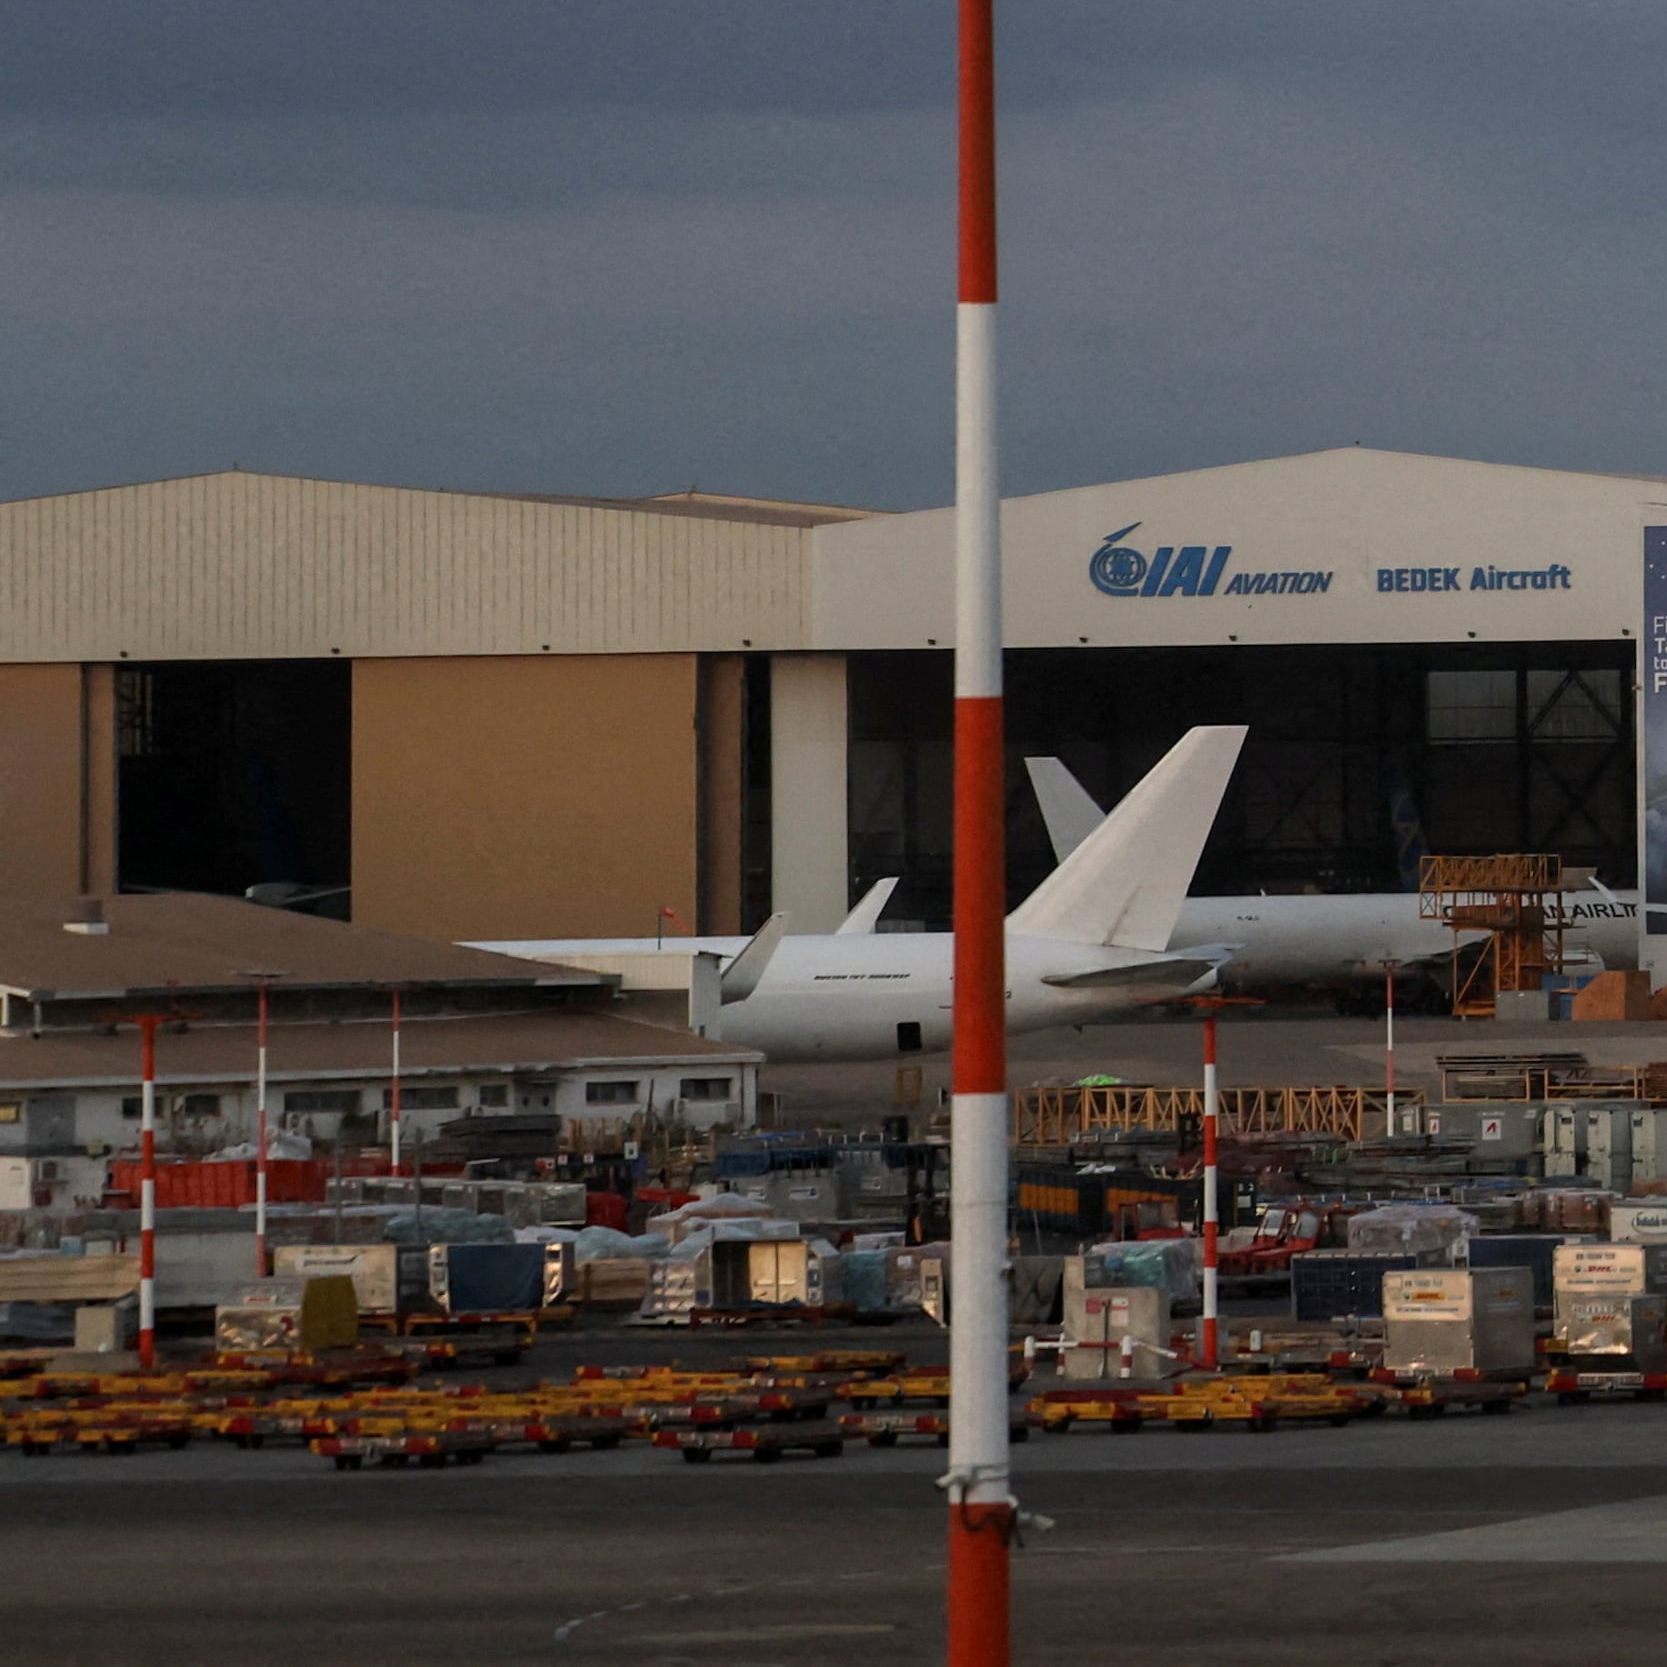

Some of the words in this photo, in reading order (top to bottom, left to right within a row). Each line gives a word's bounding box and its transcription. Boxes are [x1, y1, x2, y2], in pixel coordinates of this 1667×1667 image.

[1224, 571, 1333, 596] AVIATION
[1377, 567, 1461, 593] BEDEK
[1470, 564, 1572, 591] Aircraft
